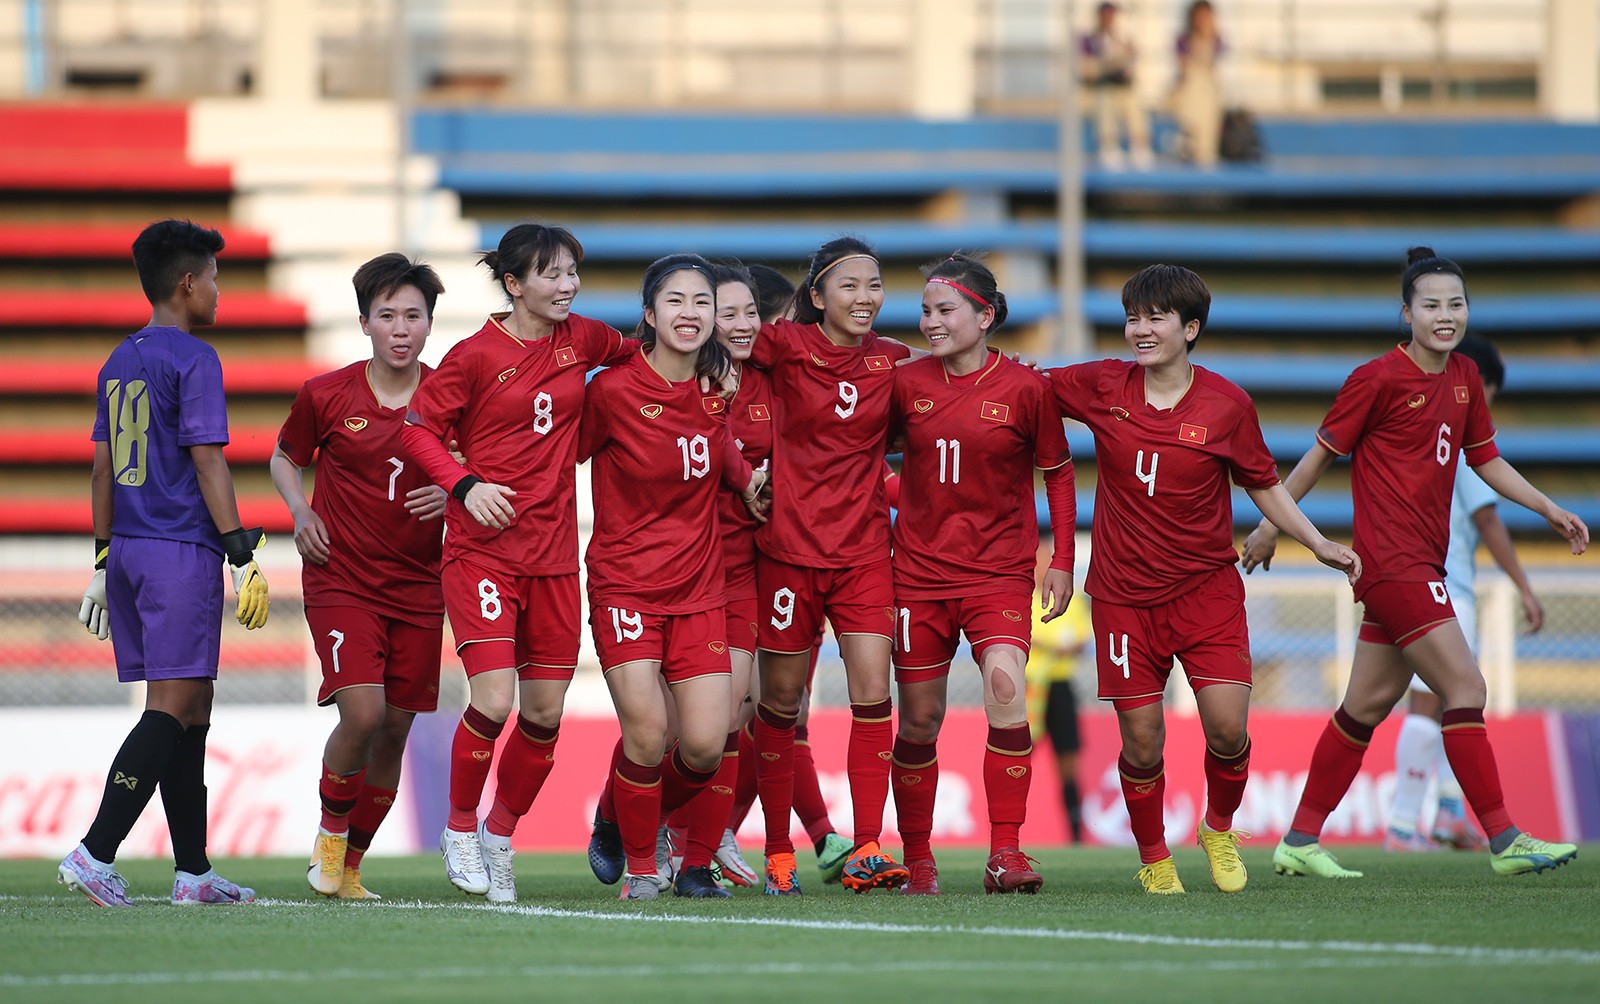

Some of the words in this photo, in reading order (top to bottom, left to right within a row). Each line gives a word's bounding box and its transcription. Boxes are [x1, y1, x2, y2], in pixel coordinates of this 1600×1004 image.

[533, 391, 554, 436] 8
[834, 380, 859, 420] 9
[105, 378, 151, 487] 18
[1436, 422, 1451, 466] 6
[386, 457, 405, 501] 7
[676, 433, 710, 481] 19
[936, 437, 961, 484] 11
[1135, 449, 1159, 497] 4
[477, 577, 503, 622] 8
[770, 586, 796, 631] 9
[607, 606, 644, 644] 19
[328, 630, 345, 674] 7
[1109, 632, 1131, 679] 4
